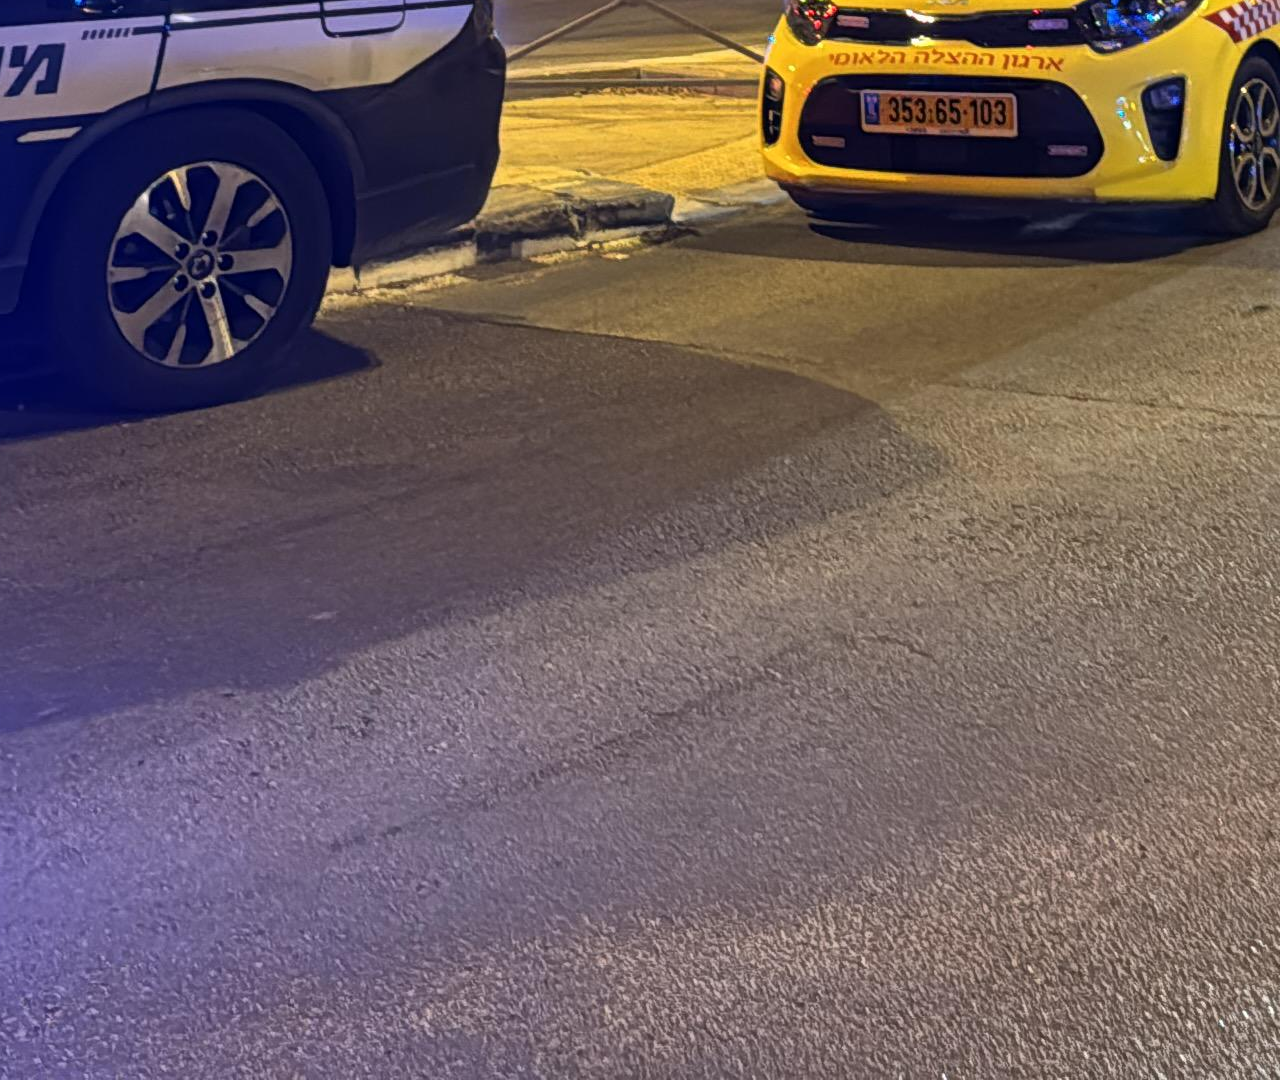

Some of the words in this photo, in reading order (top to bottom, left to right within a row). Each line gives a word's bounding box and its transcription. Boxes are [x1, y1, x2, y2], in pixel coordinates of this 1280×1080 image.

[829, 49, 906, 66] הלאומי
[913, 49, 994, 66] ההצלה
[1002, 52, 1064, 72] ארגון
